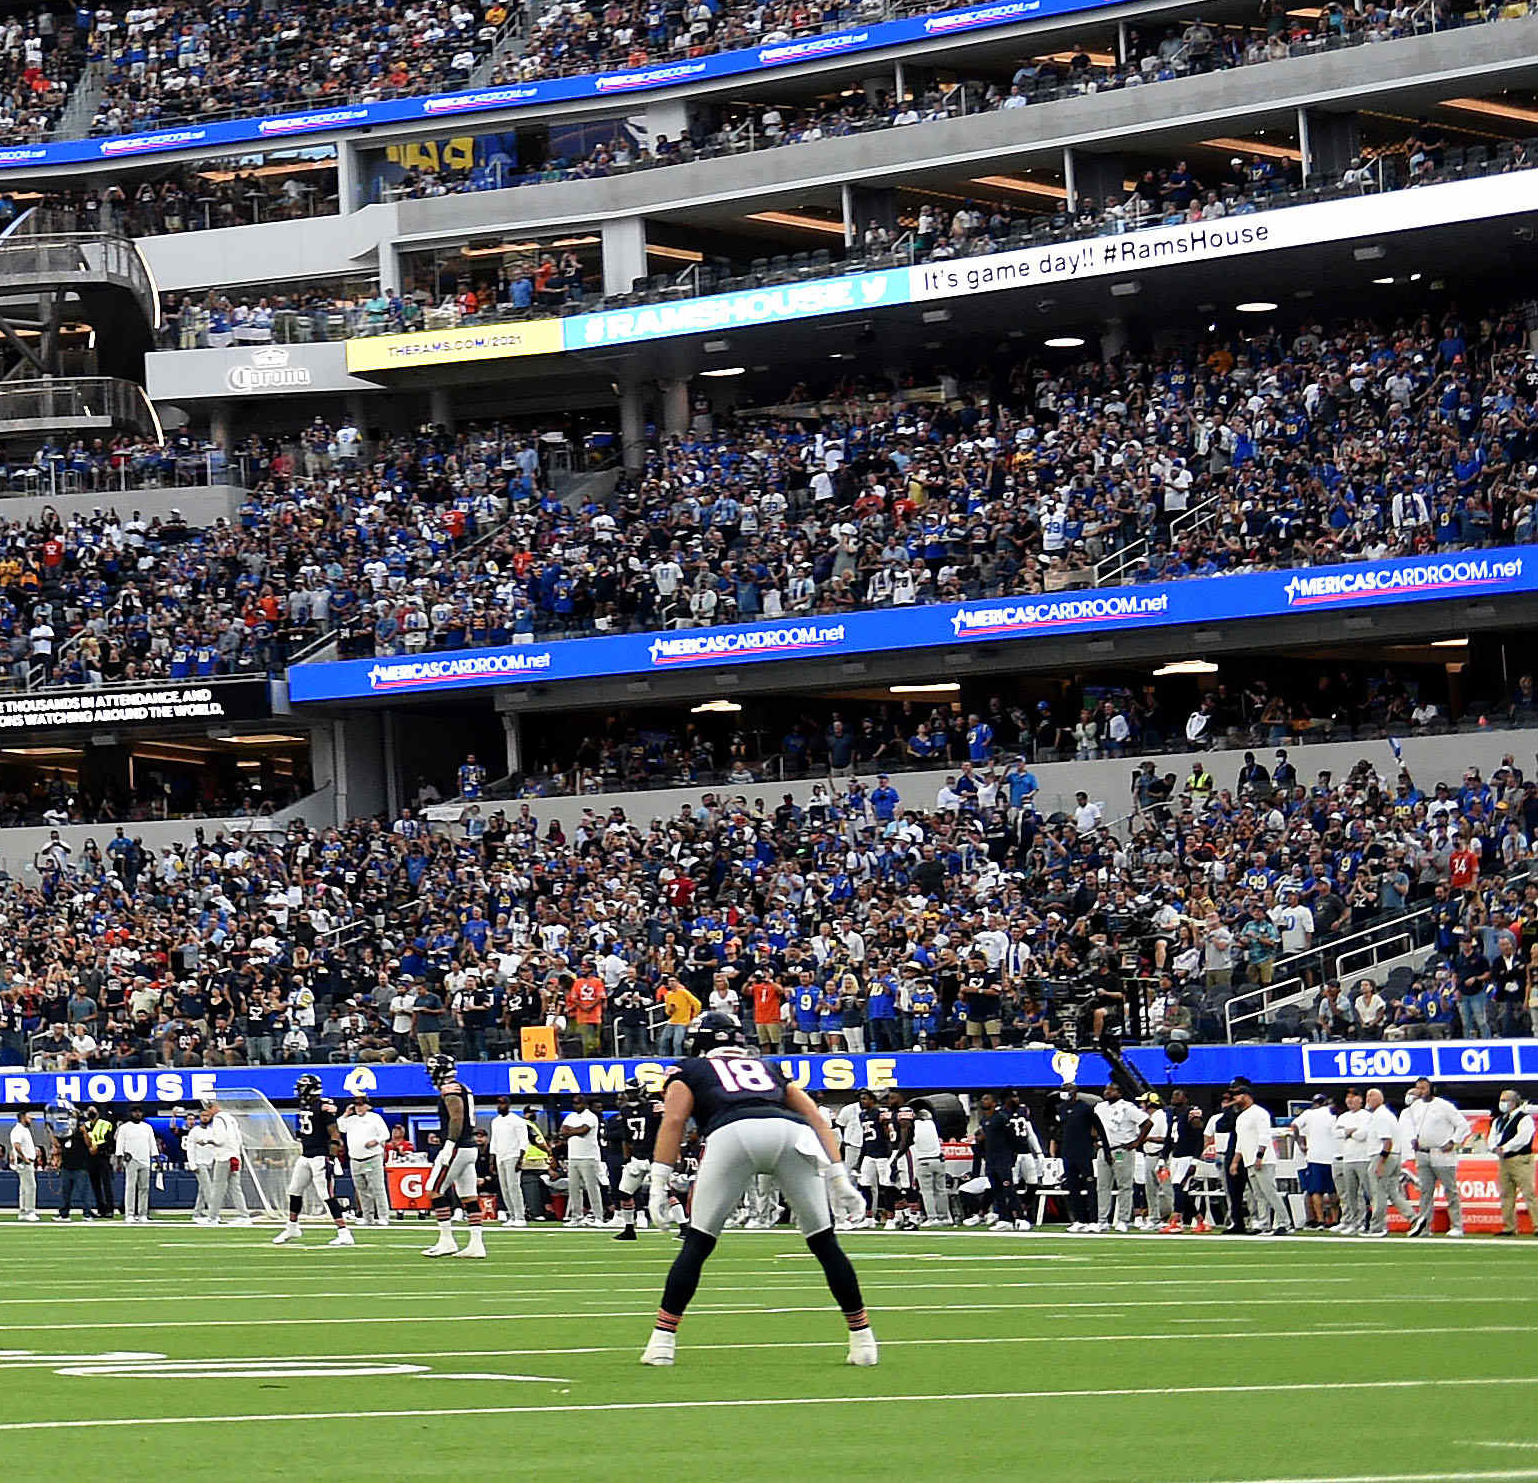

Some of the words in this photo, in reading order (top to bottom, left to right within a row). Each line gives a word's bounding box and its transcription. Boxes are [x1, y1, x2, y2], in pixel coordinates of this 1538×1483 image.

[923, 268, 959, 292] It's
[967, 262, 1033, 292] game
[1038, 247, 1096, 279] day!!
[1103, 222, 1269, 266] #RamsHouse
[226, 364, 311, 392] Corona
[801, 996, 812, 1010] 9
[1430, 1001, 1440, 1016] 9
[709, 1057, 776, 1092] 18
[1334, 1050, 1412, 1077] 15:00
[1461, 1049, 1490, 1073] Q1
[57, 1072, 219, 1104] HOUSE
[508, 1065, 664, 1094] RAMS
[399, 1173, 423, 1198] G
